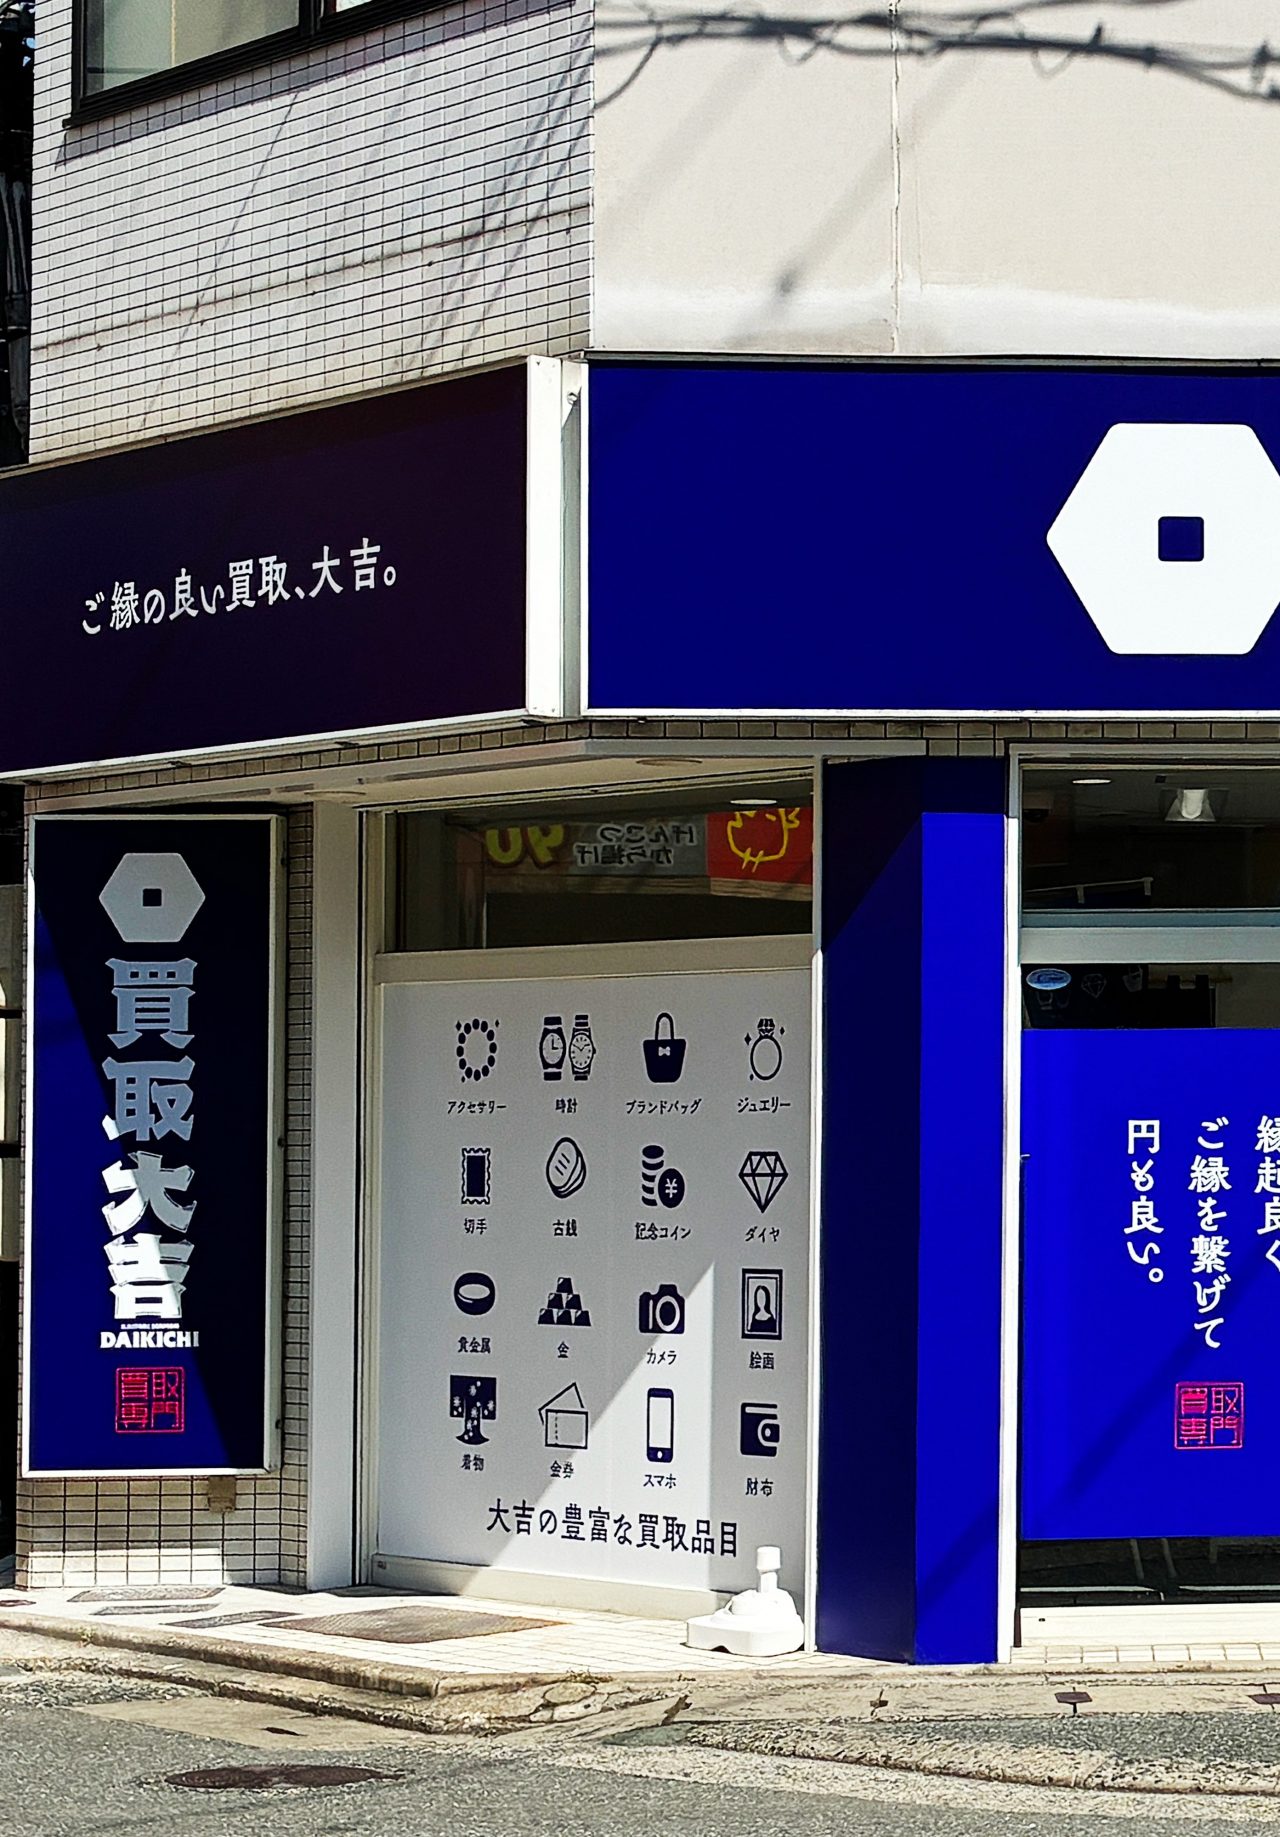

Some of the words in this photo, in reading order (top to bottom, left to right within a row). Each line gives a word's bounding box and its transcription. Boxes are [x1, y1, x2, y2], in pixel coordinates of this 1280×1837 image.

[83, 538, 396, 634] ご縁の良い買取、大吉。
[448, 1100, 506, 1114] アクセサリー
[556, 1098, 577, 1114] 時計
[626, 1099, 702, 1114] ブランドバッグ
[738, 1097, 790, 1113] ジュエリー
[102, 957, 198, 1319] 買取大吉
[1124, 1120, 1164, 1282] 円も良い。
[464, 1218, 487, 1235] 切手
[553, 1219, 577, 1236] 古銭
[635, 1222, 691, 1240] 記念コイン
[745, 1226, 779, 1243] ダイヤ
[1188, 1117, 1231, 1348] ご縁を繋げて
[100, 1331, 198, 1348] DAIKICHI
[458, 1336, 491, 1354] 貴金属
[557, 1341, 569, 1358] 金
[646, 1348, 676, 1365] カメラ
[749, 1351, 774, 1369] 絵画
[121, 1372, 179, 1400] 買取
[1180, 1388, 1240, 1416] 買取
[461, 1454, 484, 1471] 着物
[550, 1460, 574, 1478] 金券
[643, 1474, 676, 1489] スマホ
[746, 1478, 773, 1497] 財布
[487, 1498, 737, 1557] 大吉の豊富な買取品目
